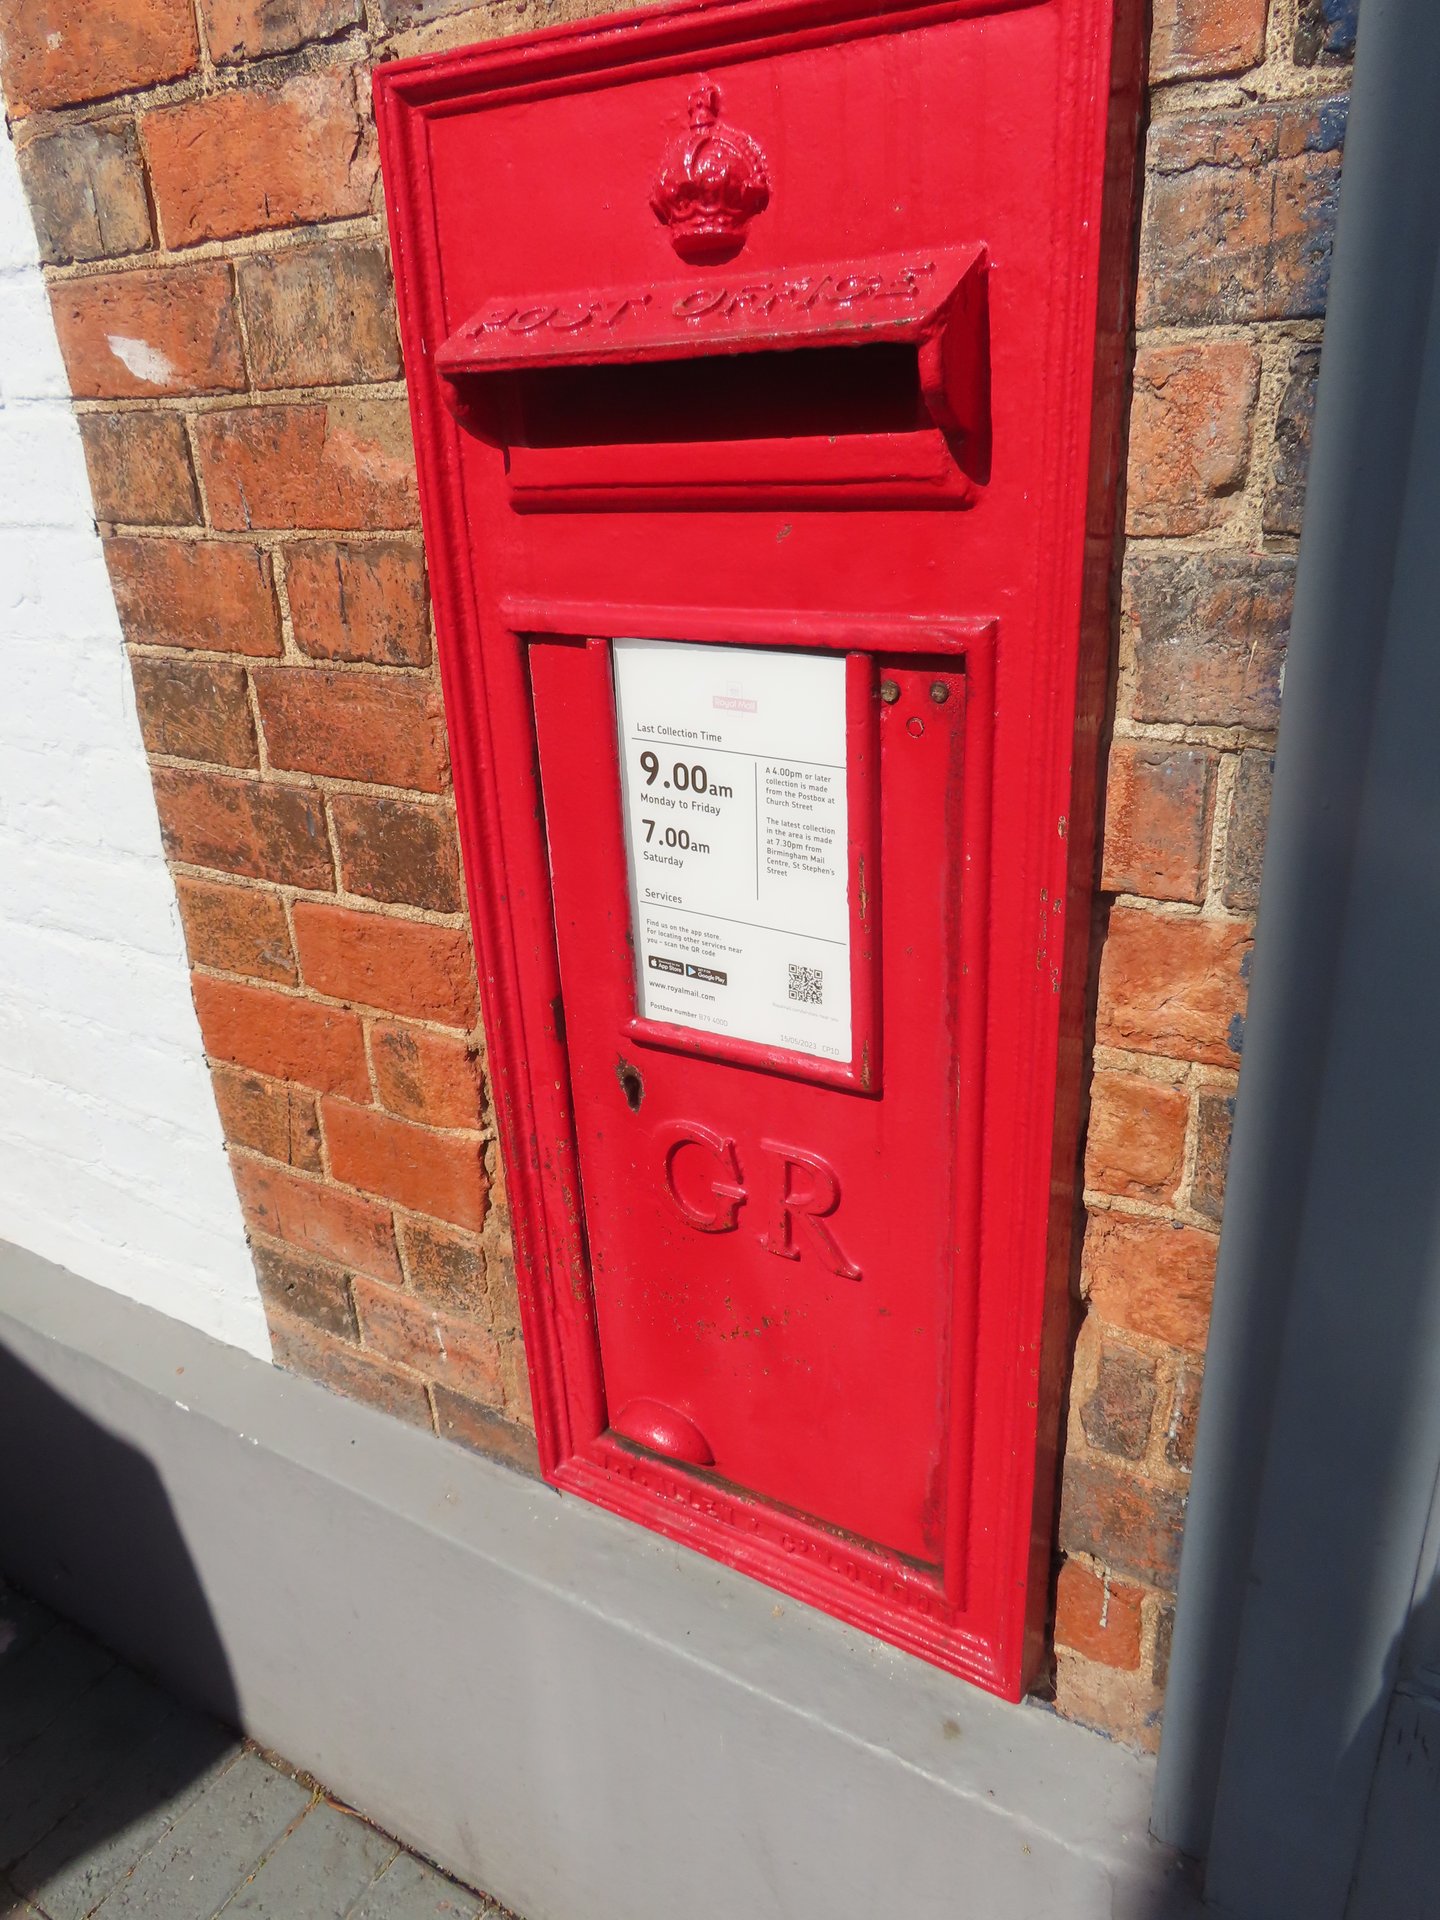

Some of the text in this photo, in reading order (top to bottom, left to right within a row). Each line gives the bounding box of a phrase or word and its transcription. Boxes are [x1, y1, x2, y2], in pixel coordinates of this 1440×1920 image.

[466, 262, 936, 339] POST OFFICE
[637, 723, 722, 742] Last Collection Time
[640, 751, 733, 798] 9.00am
[772, 767, 803, 779] 4.00pm
[815, 774, 832, 783] later
[766, 778, 828, 793] collection is made
[766, 787, 783, 796] from
[798, 792, 826, 803] Postbox
[641, 793, 721, 816] Monday to Friday
[766, 797, 813, 811] Church Street
[766, 817, 836, 834] The latest collection
[642, 819, 710, 854] 7.00am
[813, 836, 832, 844] made
[775, 838, 803, 850] 7.30pm
[805, 844, 822, 853] from
[643, 851, 684, 868] Saturday
[766, 847, 825, 864] Birmingham Mail
[766, 857, 790, 868] Centre,
[802, 863, 835, 876] Stephen's
[766, 866, 788, 877] Street
[645, 888, 683, 904] Services
[646, 918, 659, 927] Find
[690, 929, 702, 937] app
[646, 927, 743, 954] For locating other services near
[664, 940, 678, 948] scan
[679, 943, 690, 951] the
[690, 945, 700, 953] QR
[701, 948, 716, 957] code
[658, 963, 669, 971] App
[669, 965, 682, 973] Store
[697, 971, 715, 981] Google
[648, 980, 716, 1002] www.royalmail.com
[650, 1001, 673, 1012] Postbox
[674, 1008, 697, 1019] number
[651, 1119, 863, 1282] GR
